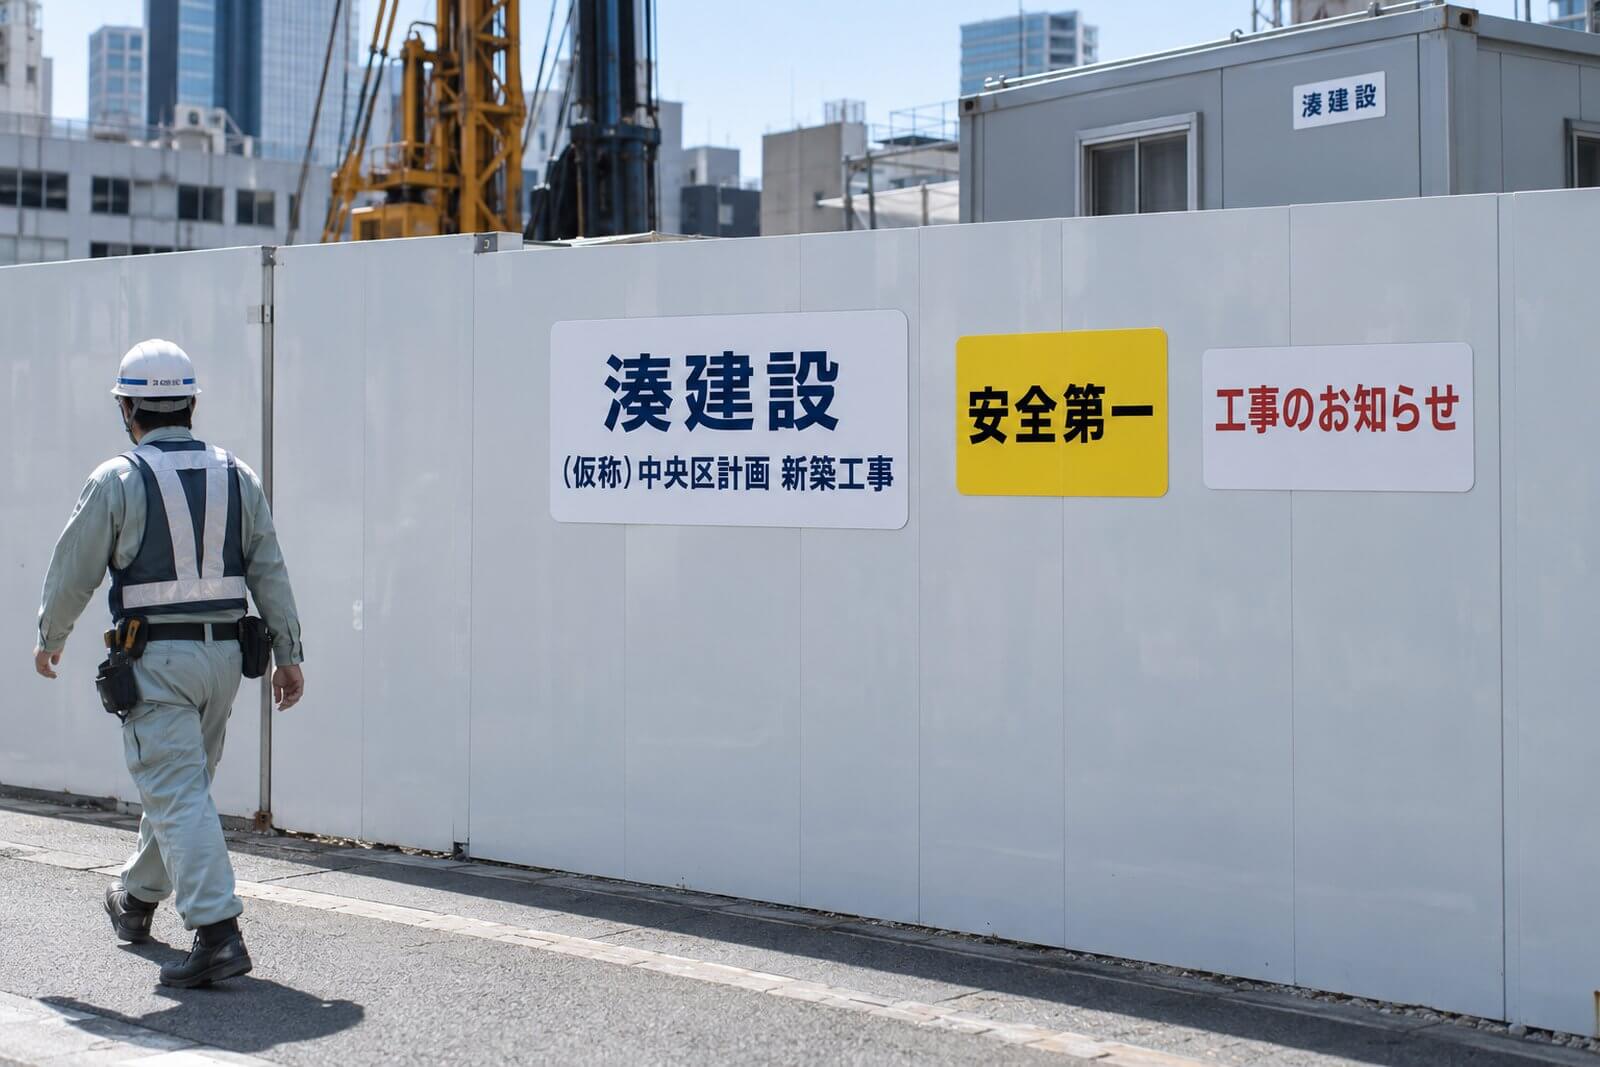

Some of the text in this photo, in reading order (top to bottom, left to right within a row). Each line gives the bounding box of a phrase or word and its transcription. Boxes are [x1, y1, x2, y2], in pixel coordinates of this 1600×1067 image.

[1302, 83, 1376, 118] 湊建設
[604, 351, 839, 432] 湊建設
[969, 383, 1153, 444] 安全第一
[1216, 384, 1459, 434] 工事のお知らせ
[781, 455, 894, 492] 新築工事
